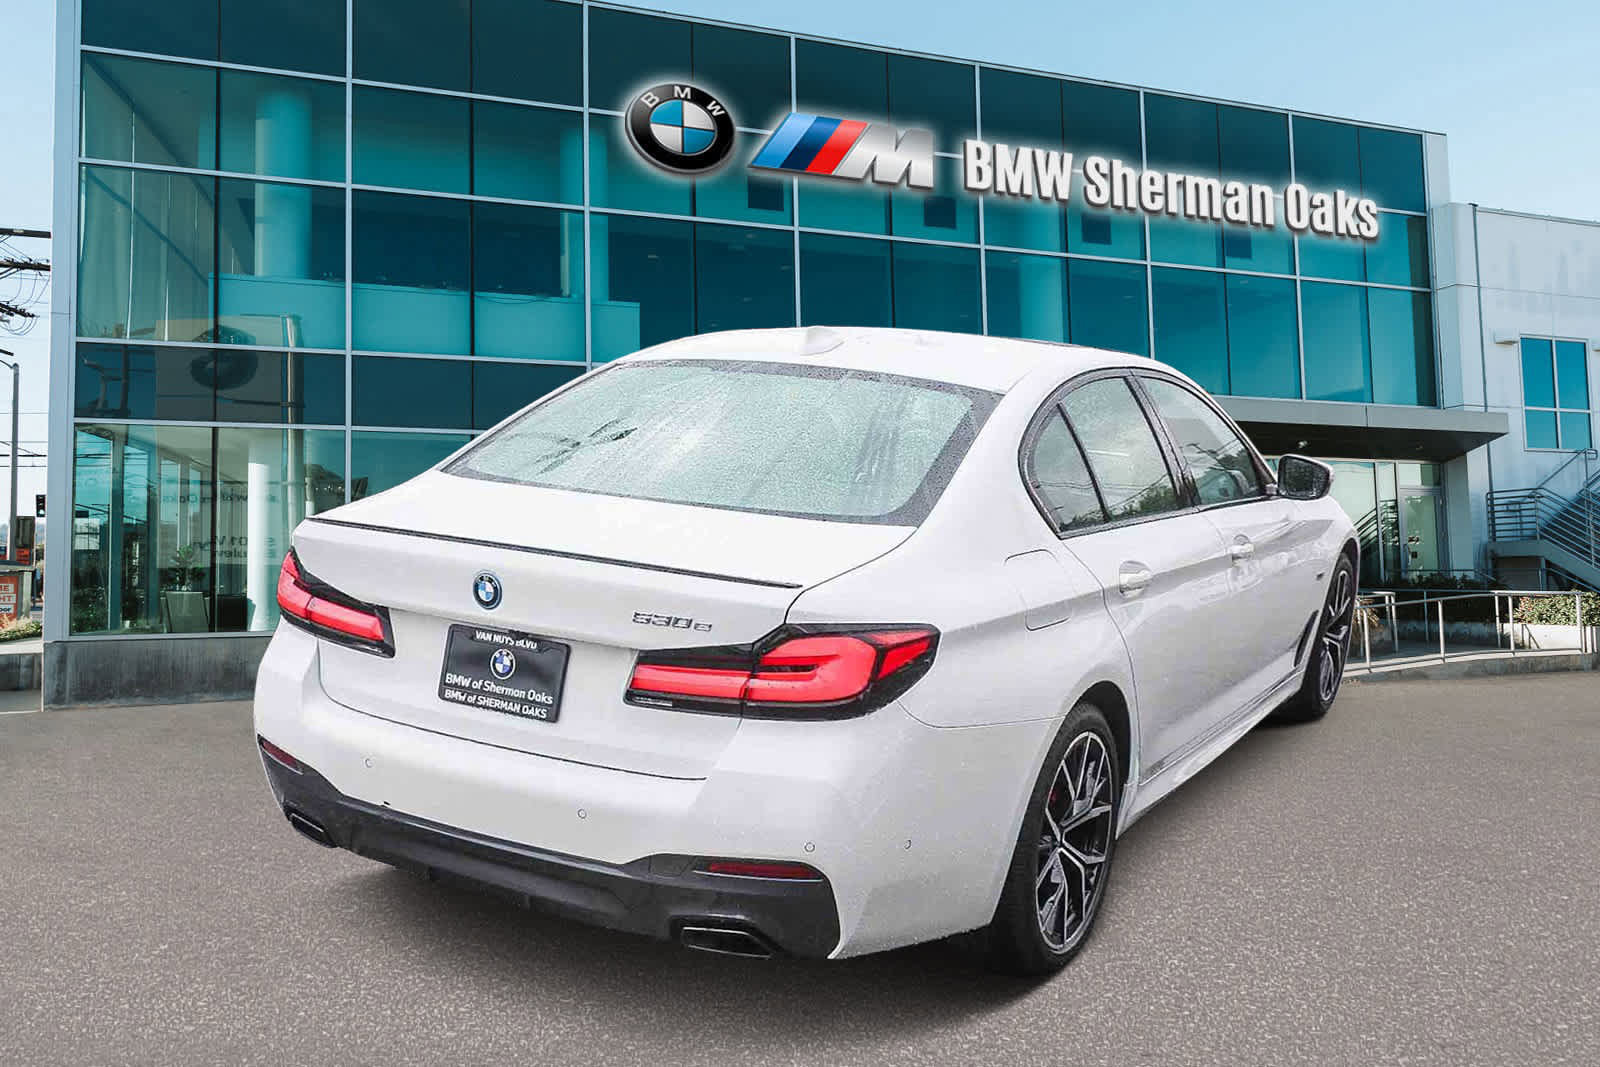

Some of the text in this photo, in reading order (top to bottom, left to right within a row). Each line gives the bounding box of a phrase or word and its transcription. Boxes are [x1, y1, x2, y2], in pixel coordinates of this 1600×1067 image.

[641, 85, 726, 118] BMW
[963, 139, 1379, 241] BMW Sherman Oaks
[475, 630, 538, 650] VAN NUYS BLVD
[444, 689, 548, 719] BMW of SHERMAN OAKS
[445, 673, 554, 705] BMW of Sherman Oaks
